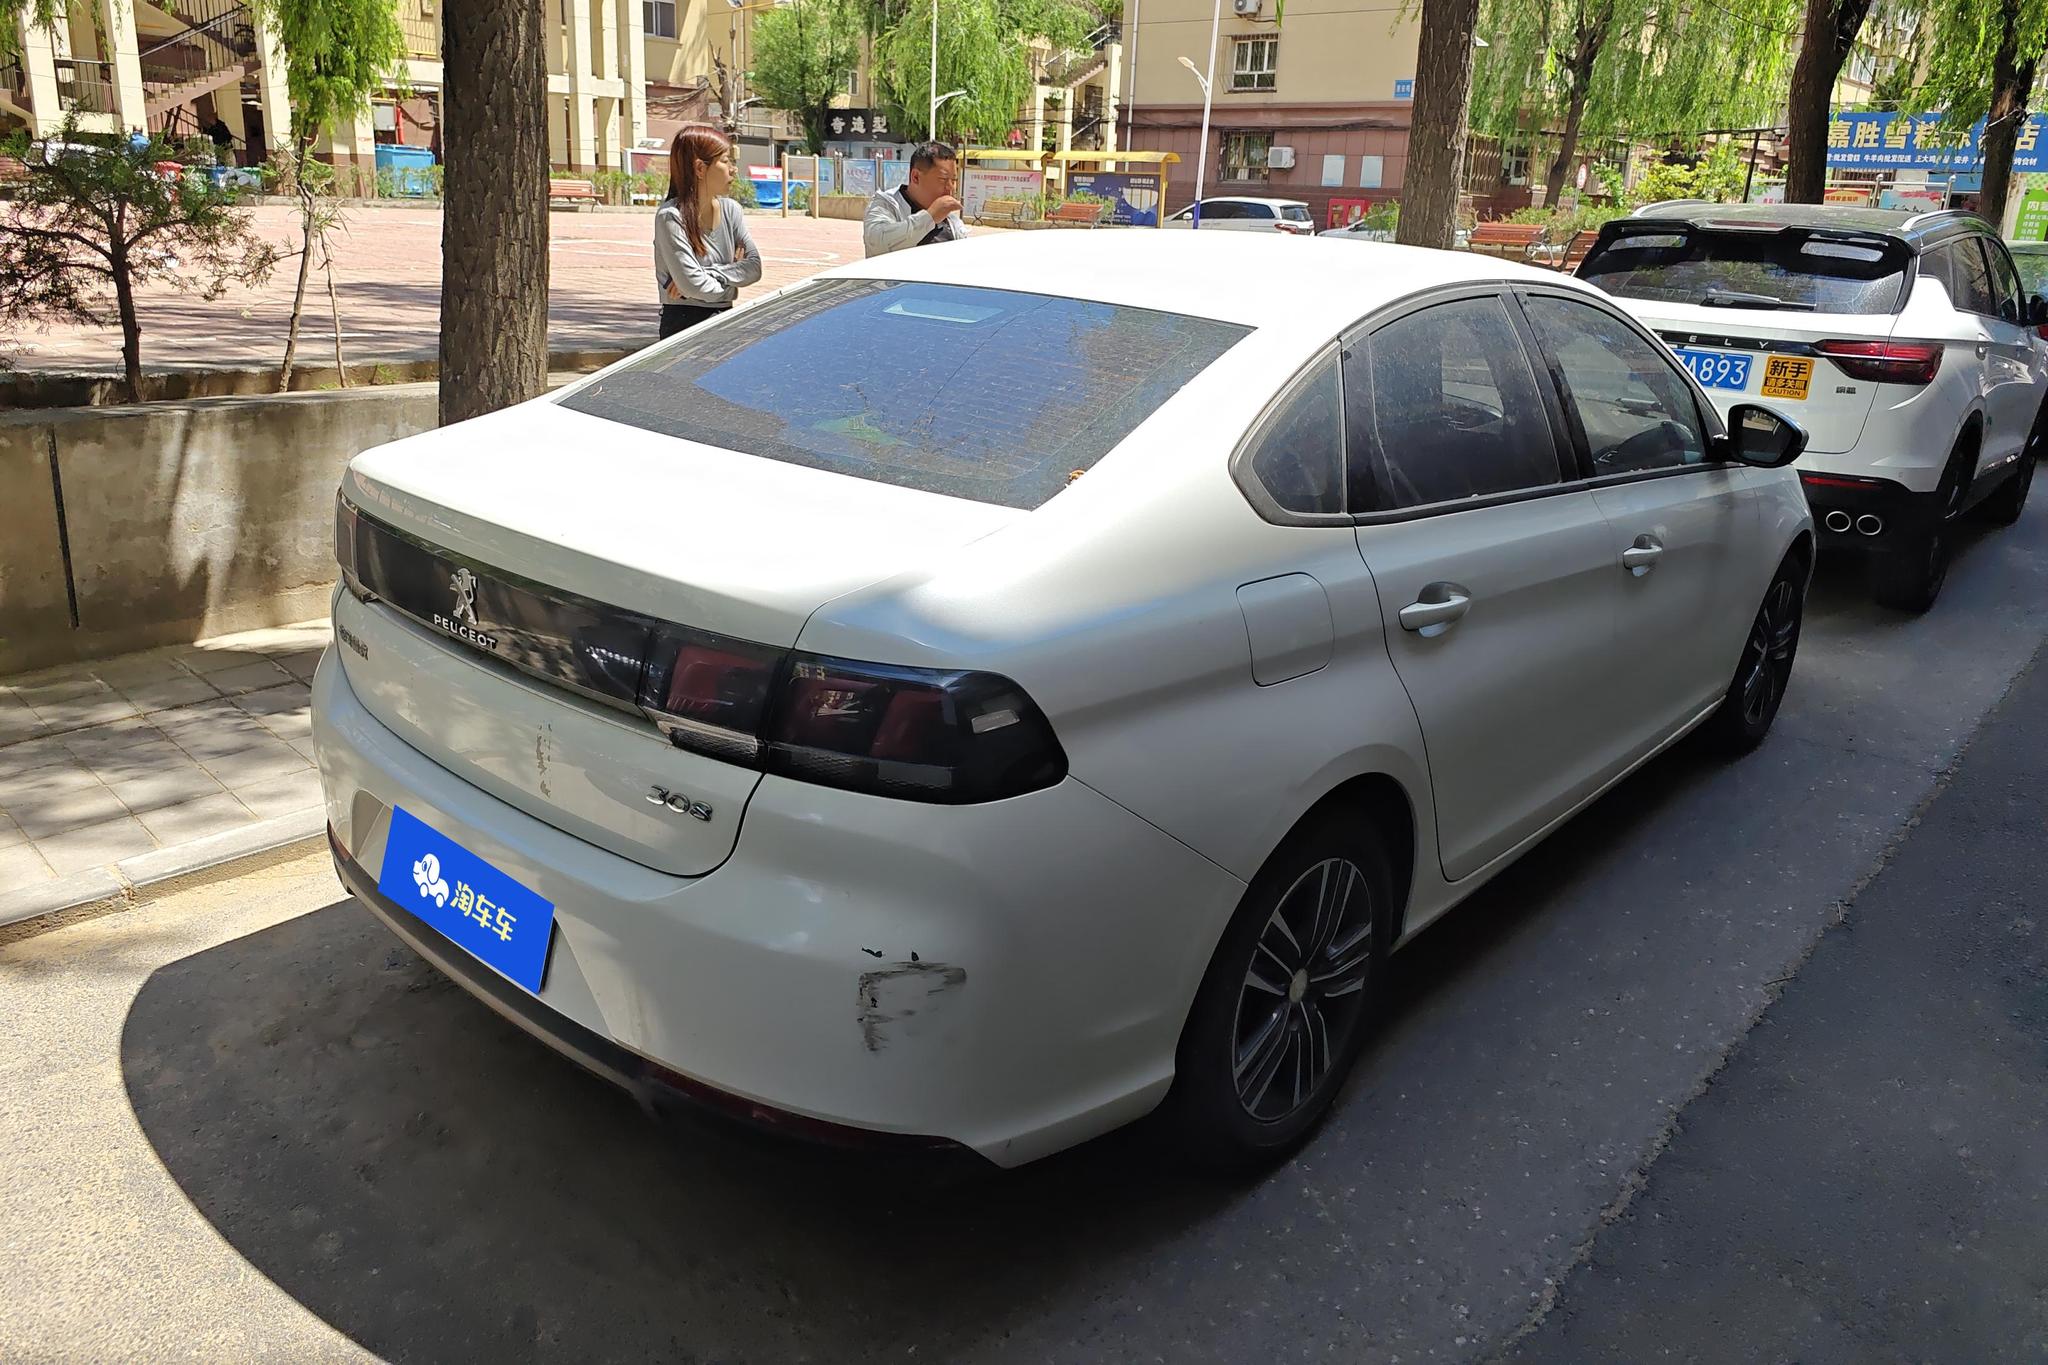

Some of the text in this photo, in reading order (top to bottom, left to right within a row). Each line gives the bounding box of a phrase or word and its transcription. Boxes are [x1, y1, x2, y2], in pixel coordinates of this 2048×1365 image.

[830, 115, 888, 134] 奇造型
[1828, 120, 2041, 150] 嘉胜雪糕店
[1769, 360, 1808, 378] 新手
[1767, 387, 1801, 397] CAUTION
[433, 613, 497, 649] PEUGEOT
[646, 785, 713, 822] 308
